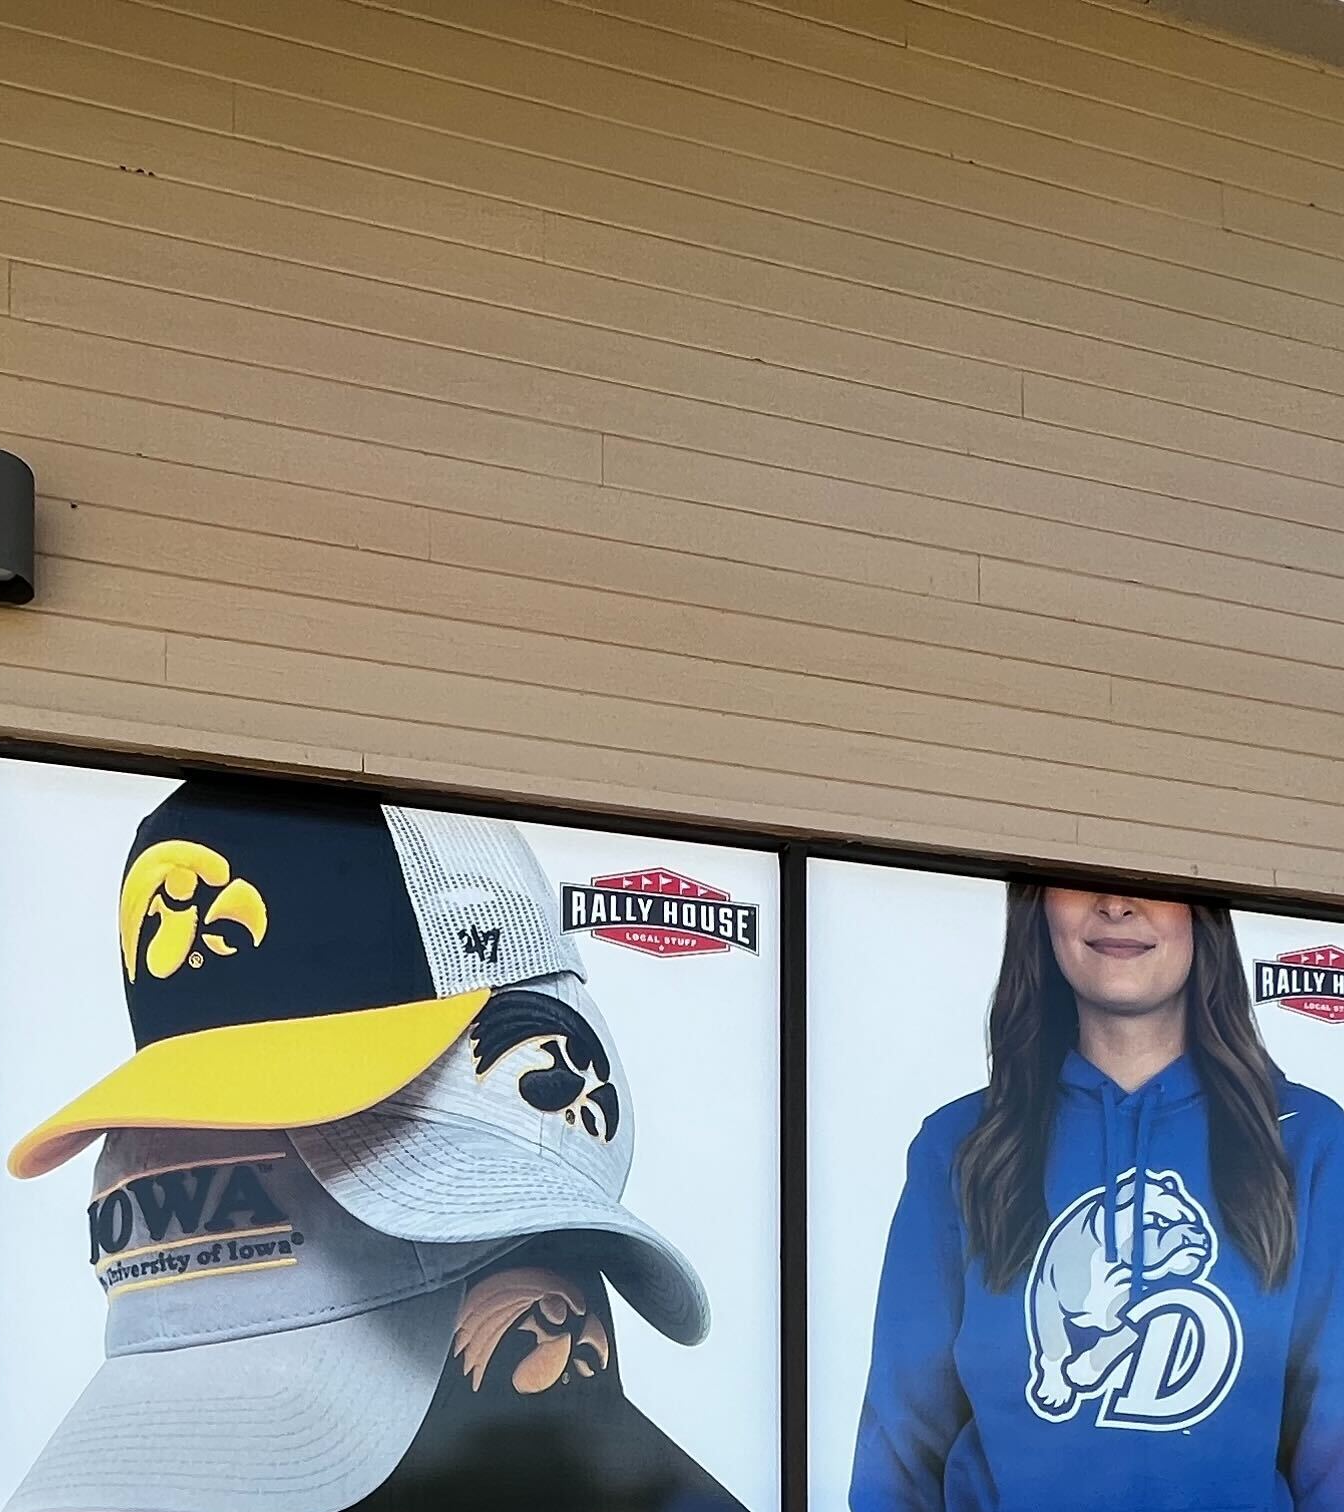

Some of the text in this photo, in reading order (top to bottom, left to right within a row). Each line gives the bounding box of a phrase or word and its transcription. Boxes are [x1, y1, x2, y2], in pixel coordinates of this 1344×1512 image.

[572, 890, 751, 945] RALLY HOUSE
[625, 931, 698, 948] LOCAL STUFF
[1262, 966, 1325, 998] RALLY
[1304, 1001, 1331, 1012] LOCAL
[87, 1165, 288, 1265] IOWA
[197, 1243, 223, 1265] of
[227, 1240, 293, 1260] Iowa
